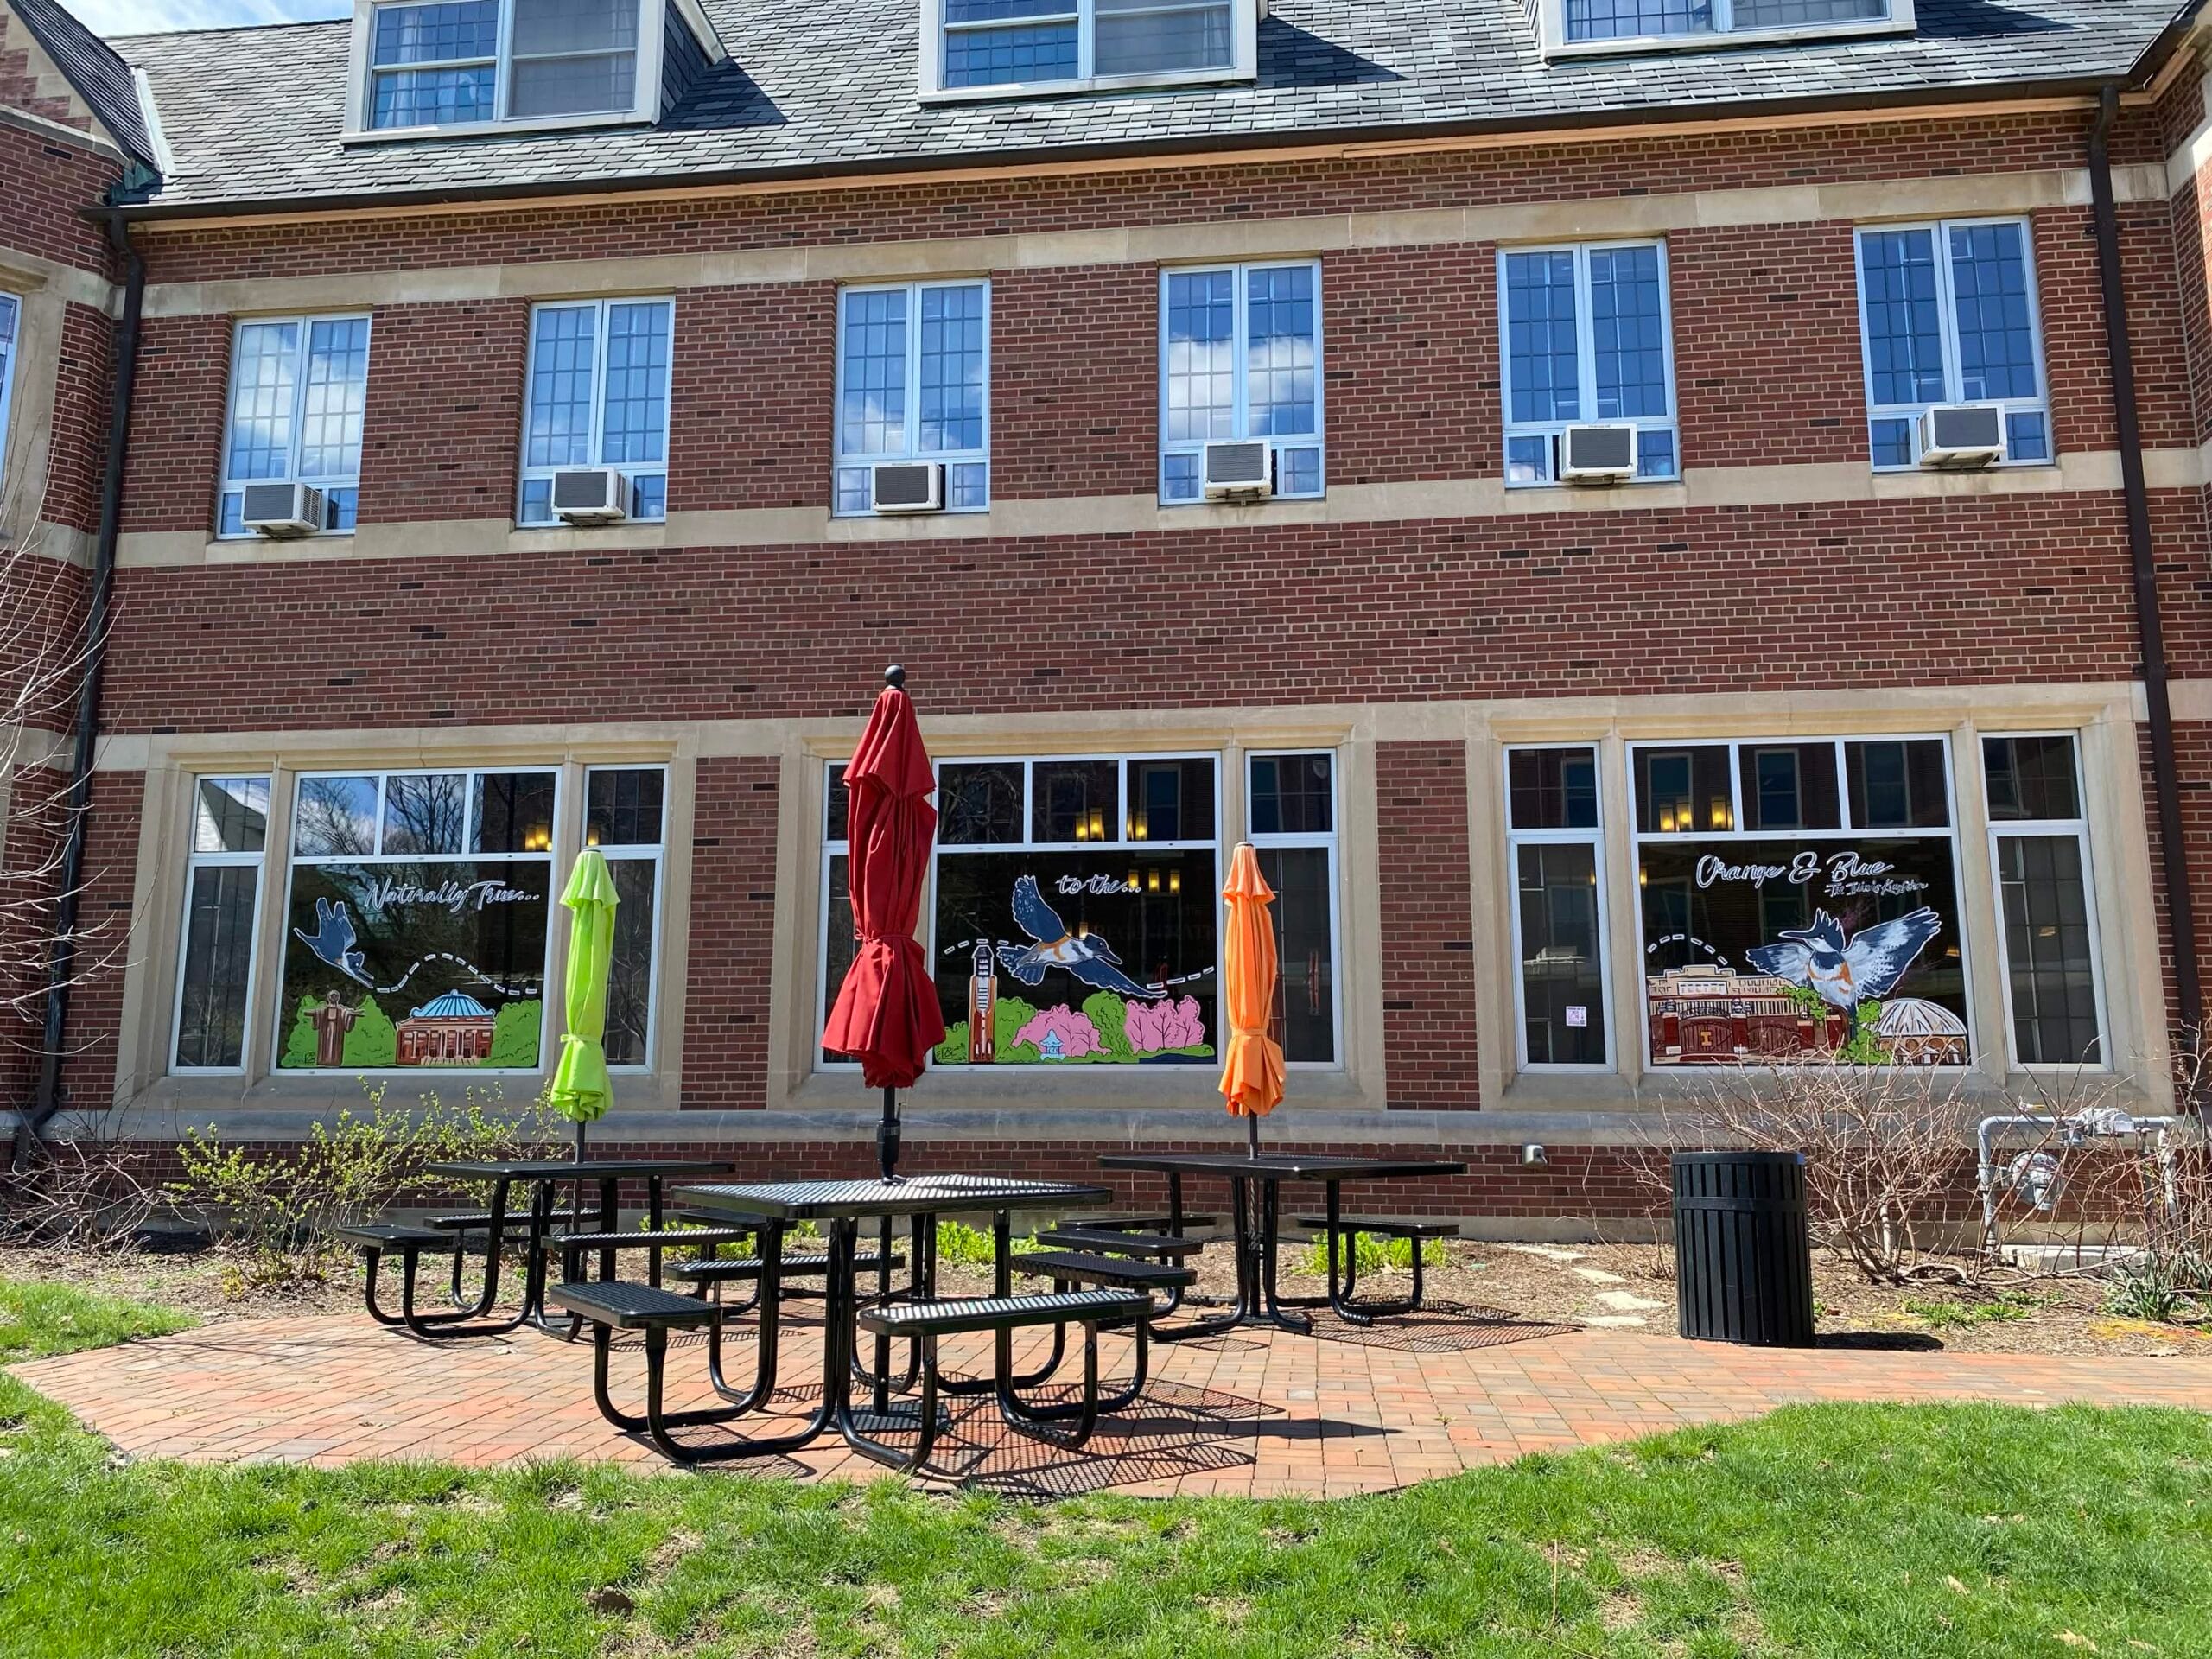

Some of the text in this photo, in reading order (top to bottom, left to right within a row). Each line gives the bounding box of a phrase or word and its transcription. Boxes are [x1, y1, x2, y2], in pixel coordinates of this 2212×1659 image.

[1055, 874, 1088, 894] to
[1695, 851, 1895, 889] Orange & Blue
[364, 875, 470, 913] Naturally
